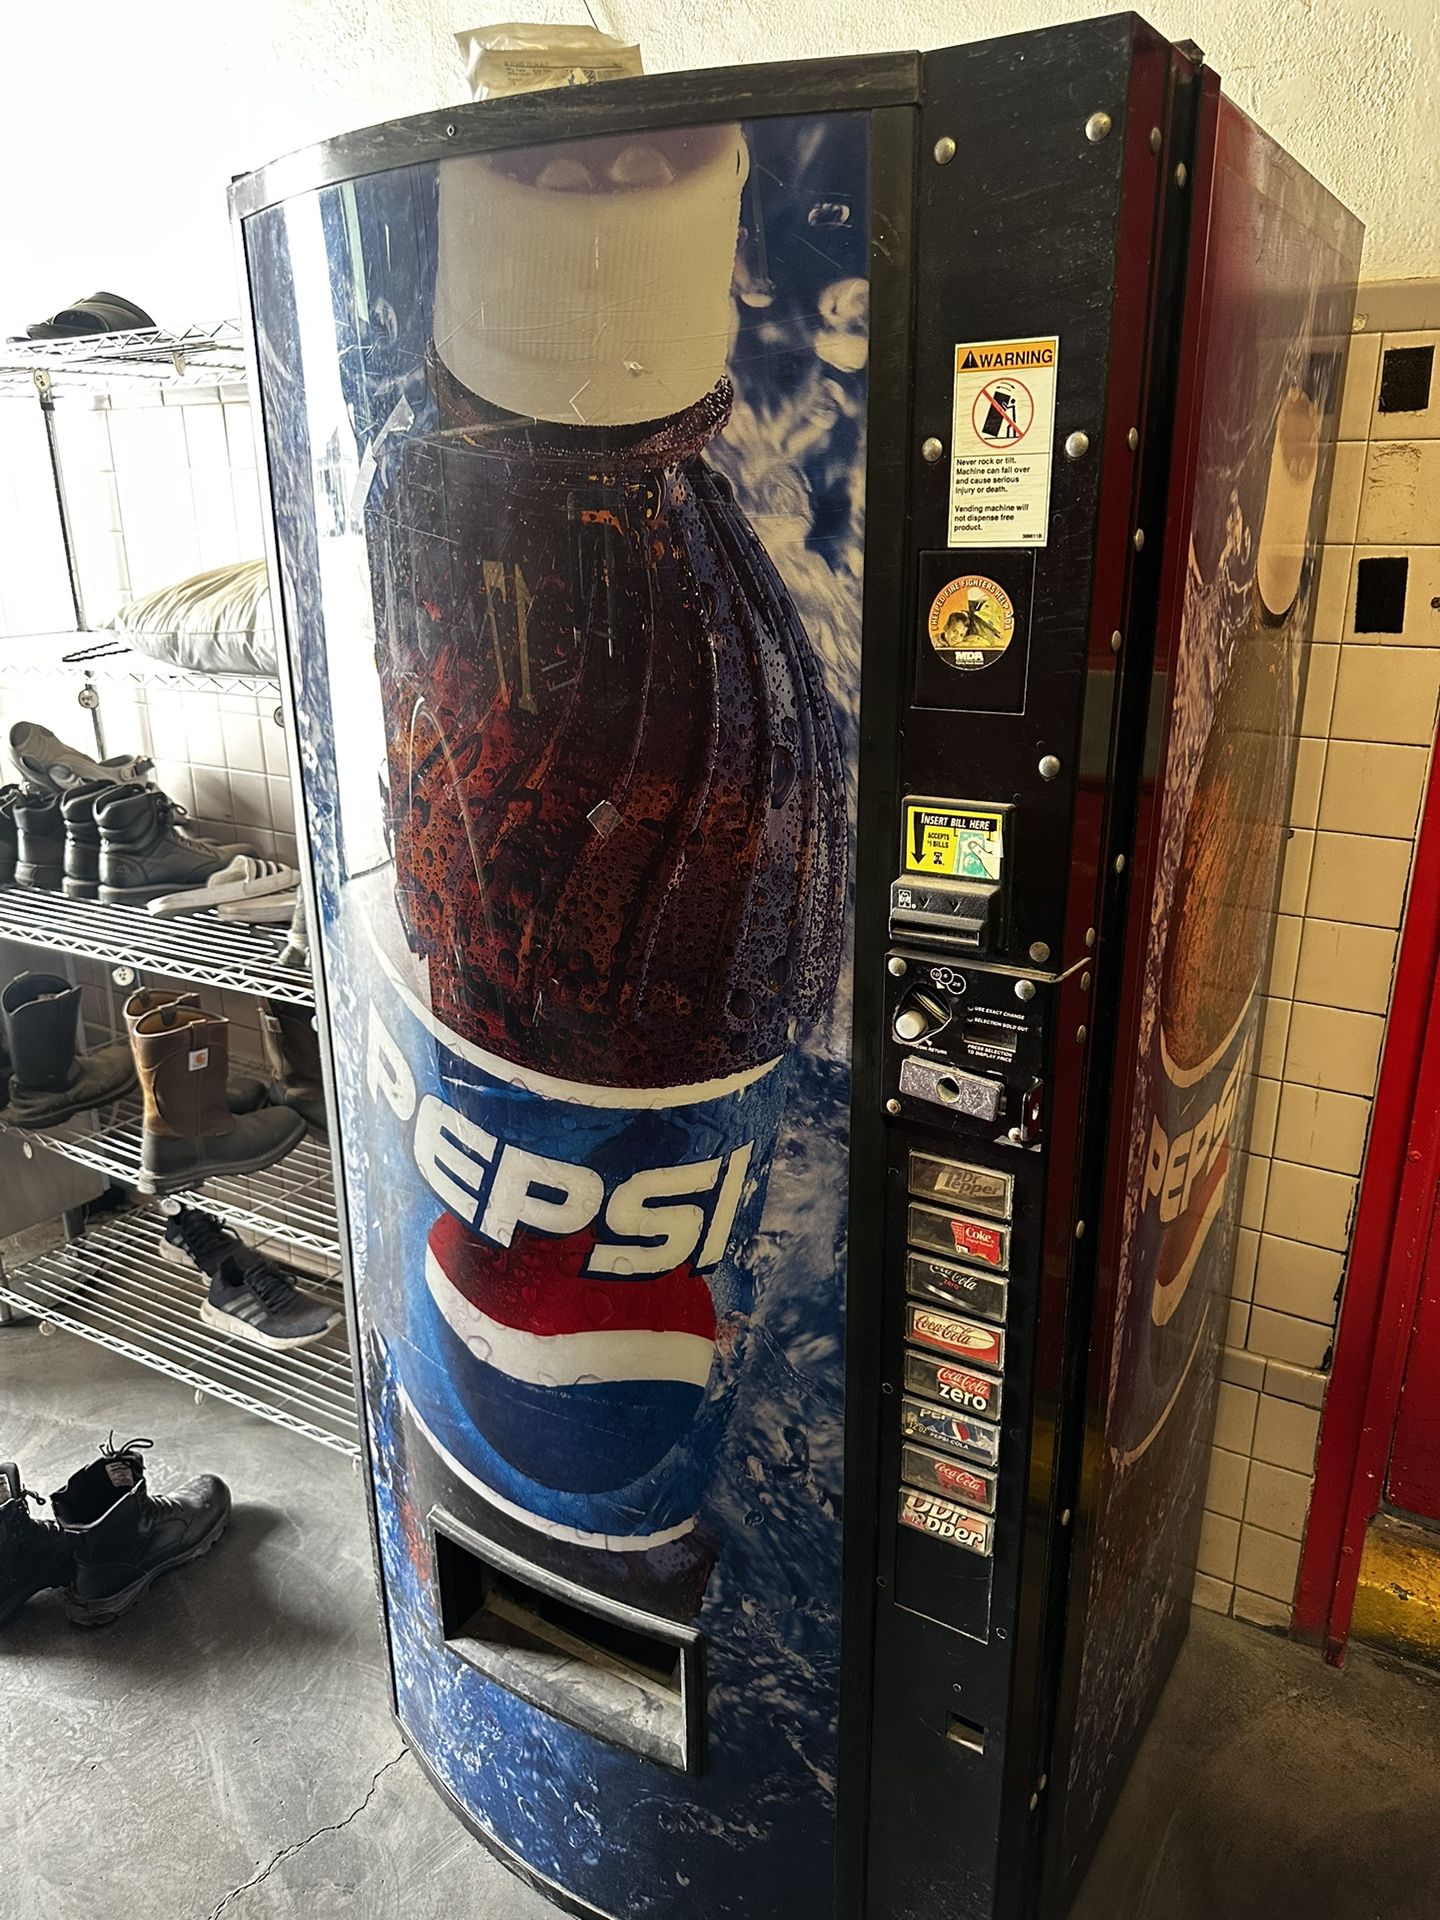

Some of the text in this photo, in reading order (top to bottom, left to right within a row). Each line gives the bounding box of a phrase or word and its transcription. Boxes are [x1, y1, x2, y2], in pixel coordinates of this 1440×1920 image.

[980, 349, 1053, 368] WARNING
[956, 487, 975, 495] injury
[955, 505, 983, 513] Vending
[967, 514, 999, 522] dispense
[954, 524, 982, 532] product.
[932, 596, 947, 625] HELPED
[945, 582, 960, 598] FIRE
[961, 578, 997, 593] FIGHTERS
[994, 589, 1009, 609] HELP
[955, 651, 984, 661] MDA
[921, 813, 990, 830] INSERT BILL HERE
[928, 832, 950, 840] ACCEPTS
[986, 1008, 1002, 1016] EXACT
[1003, 1011, 1025, 1020] CHANGE
[974, 1017, 1000, 1027] SELECTION
[1002, 1022, 1016, 1030] SOLD
[928, 1046, 948, 1055] RETURN
[967, 1044, 1013, 1057] PRESS SELECTION
[975, 1050, 996, 1059] DISPLAY
[996, 1055, 1012, 1063] PRICE
[366, 998, 754, 1276] PEPSI
[944, 1170, 1001, 1194] Pepper
[963, 1172, 982, 1184] Dr
[965, 1227, 992, 1242] Coke
[916, 1315, 972, 1345] Coca-Cola
[937, 1367, 989, 1394] Coca-Cola
[939, 1383, 987, 1411] zero
[935, 1462, 981, 1491] Coca-Cola
